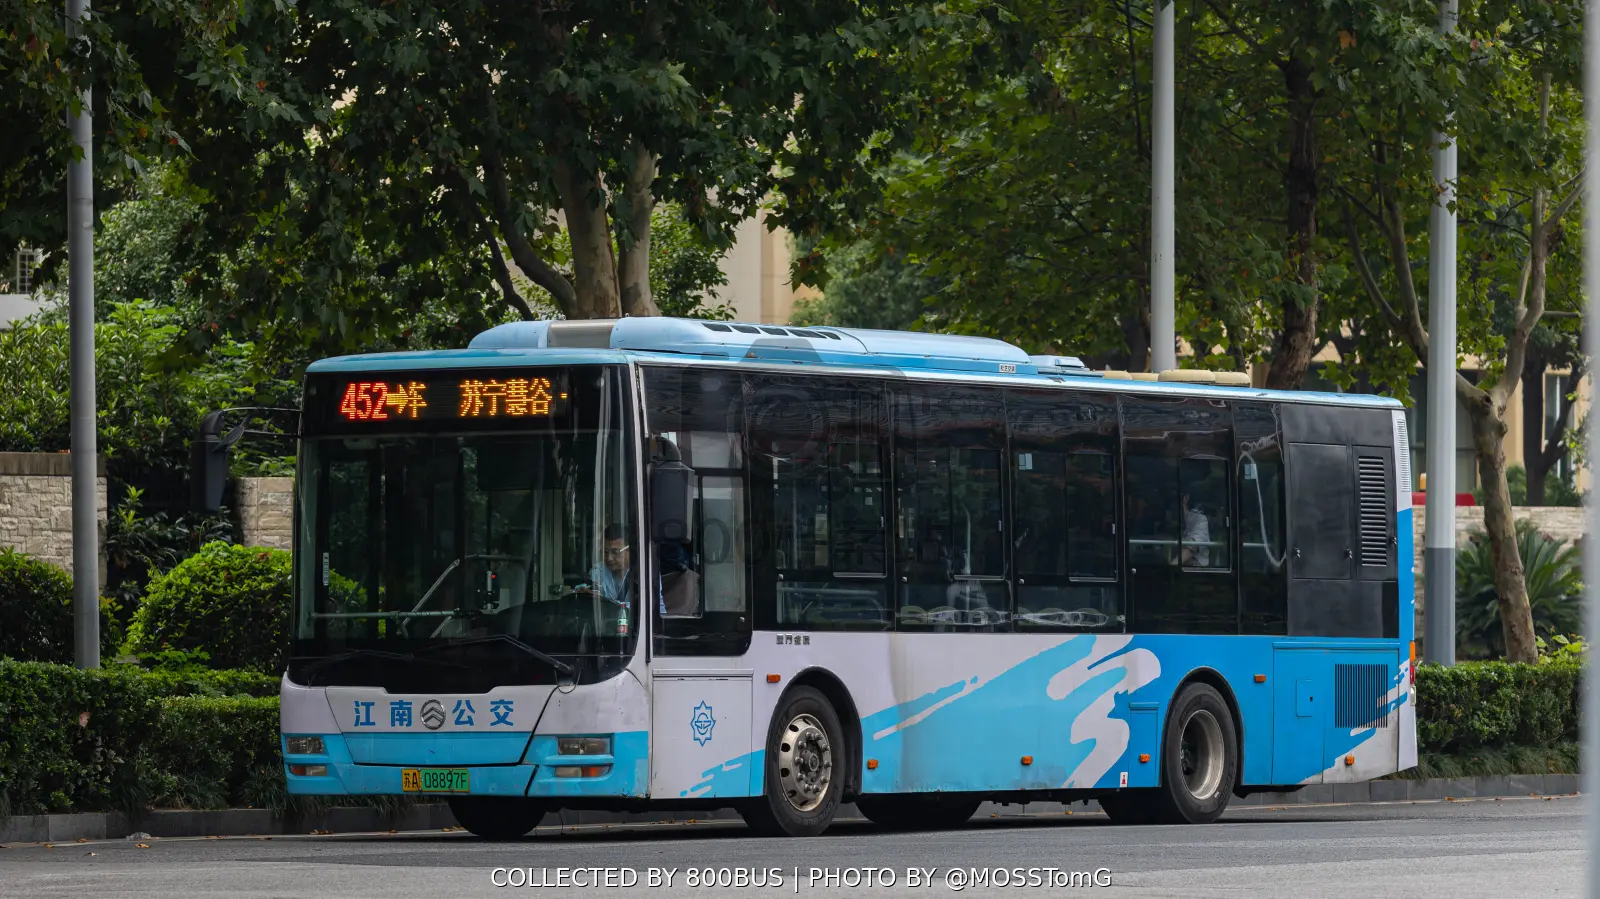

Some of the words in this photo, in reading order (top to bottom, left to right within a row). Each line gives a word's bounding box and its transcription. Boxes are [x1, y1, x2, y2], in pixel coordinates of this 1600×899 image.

[340, 382, 389, 420] 452
[459, 377, 553, 417] 苏宁慧谷
[353, 699, 413, 728] 江南
[451, 698, 515, 728] 公交
